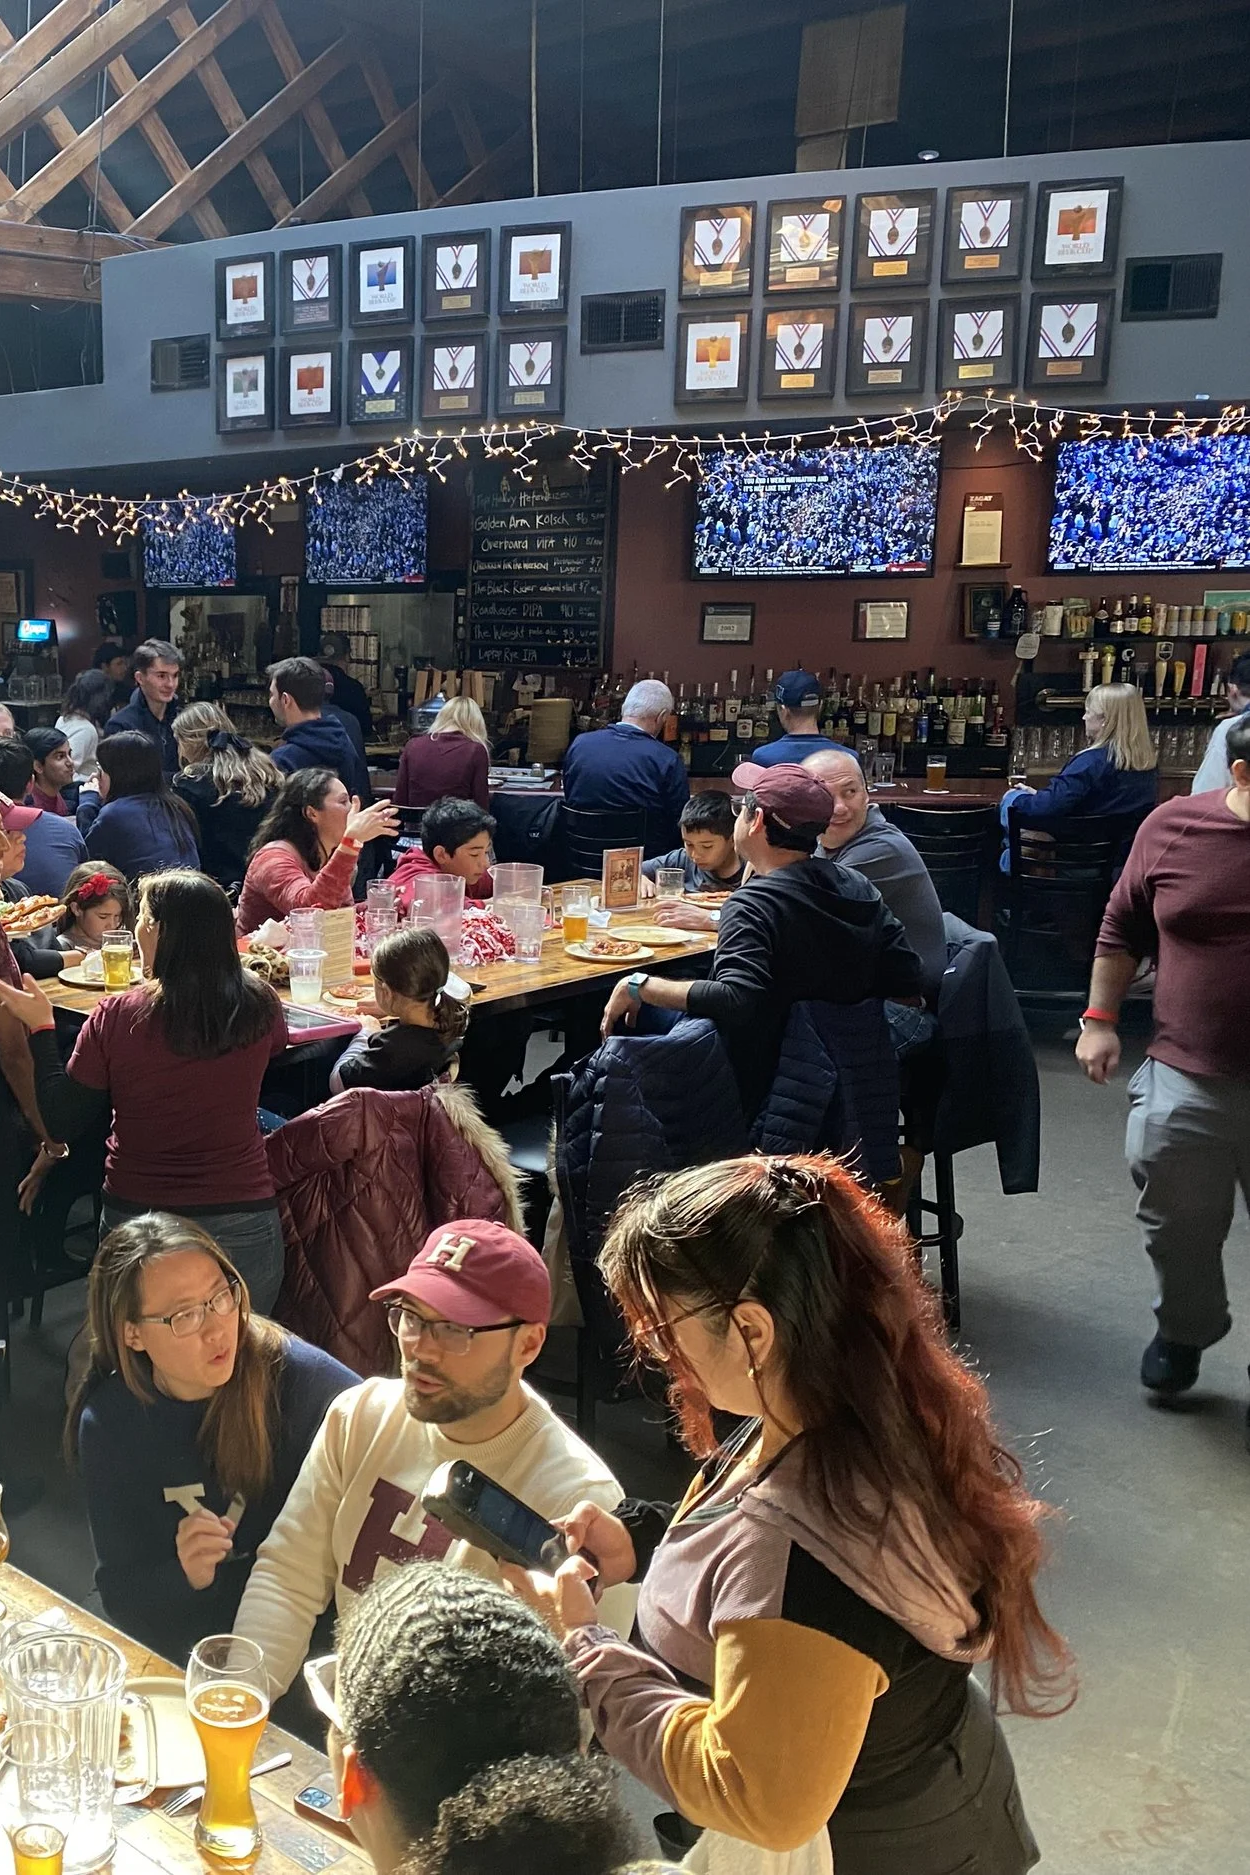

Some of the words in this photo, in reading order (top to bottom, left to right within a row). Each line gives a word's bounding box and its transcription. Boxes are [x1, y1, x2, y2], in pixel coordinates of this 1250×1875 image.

[474, 515, 507, 531] Golden
[509, 514, 531, 529] Arm
[481, 537, 529, 552] Overboard
[487, 580, 511, 595] Black
[472, 602, 518, 617] Roadhouse
[523, 603, 543, 617] DIPA
[425, 1232, 477, 1273] H
